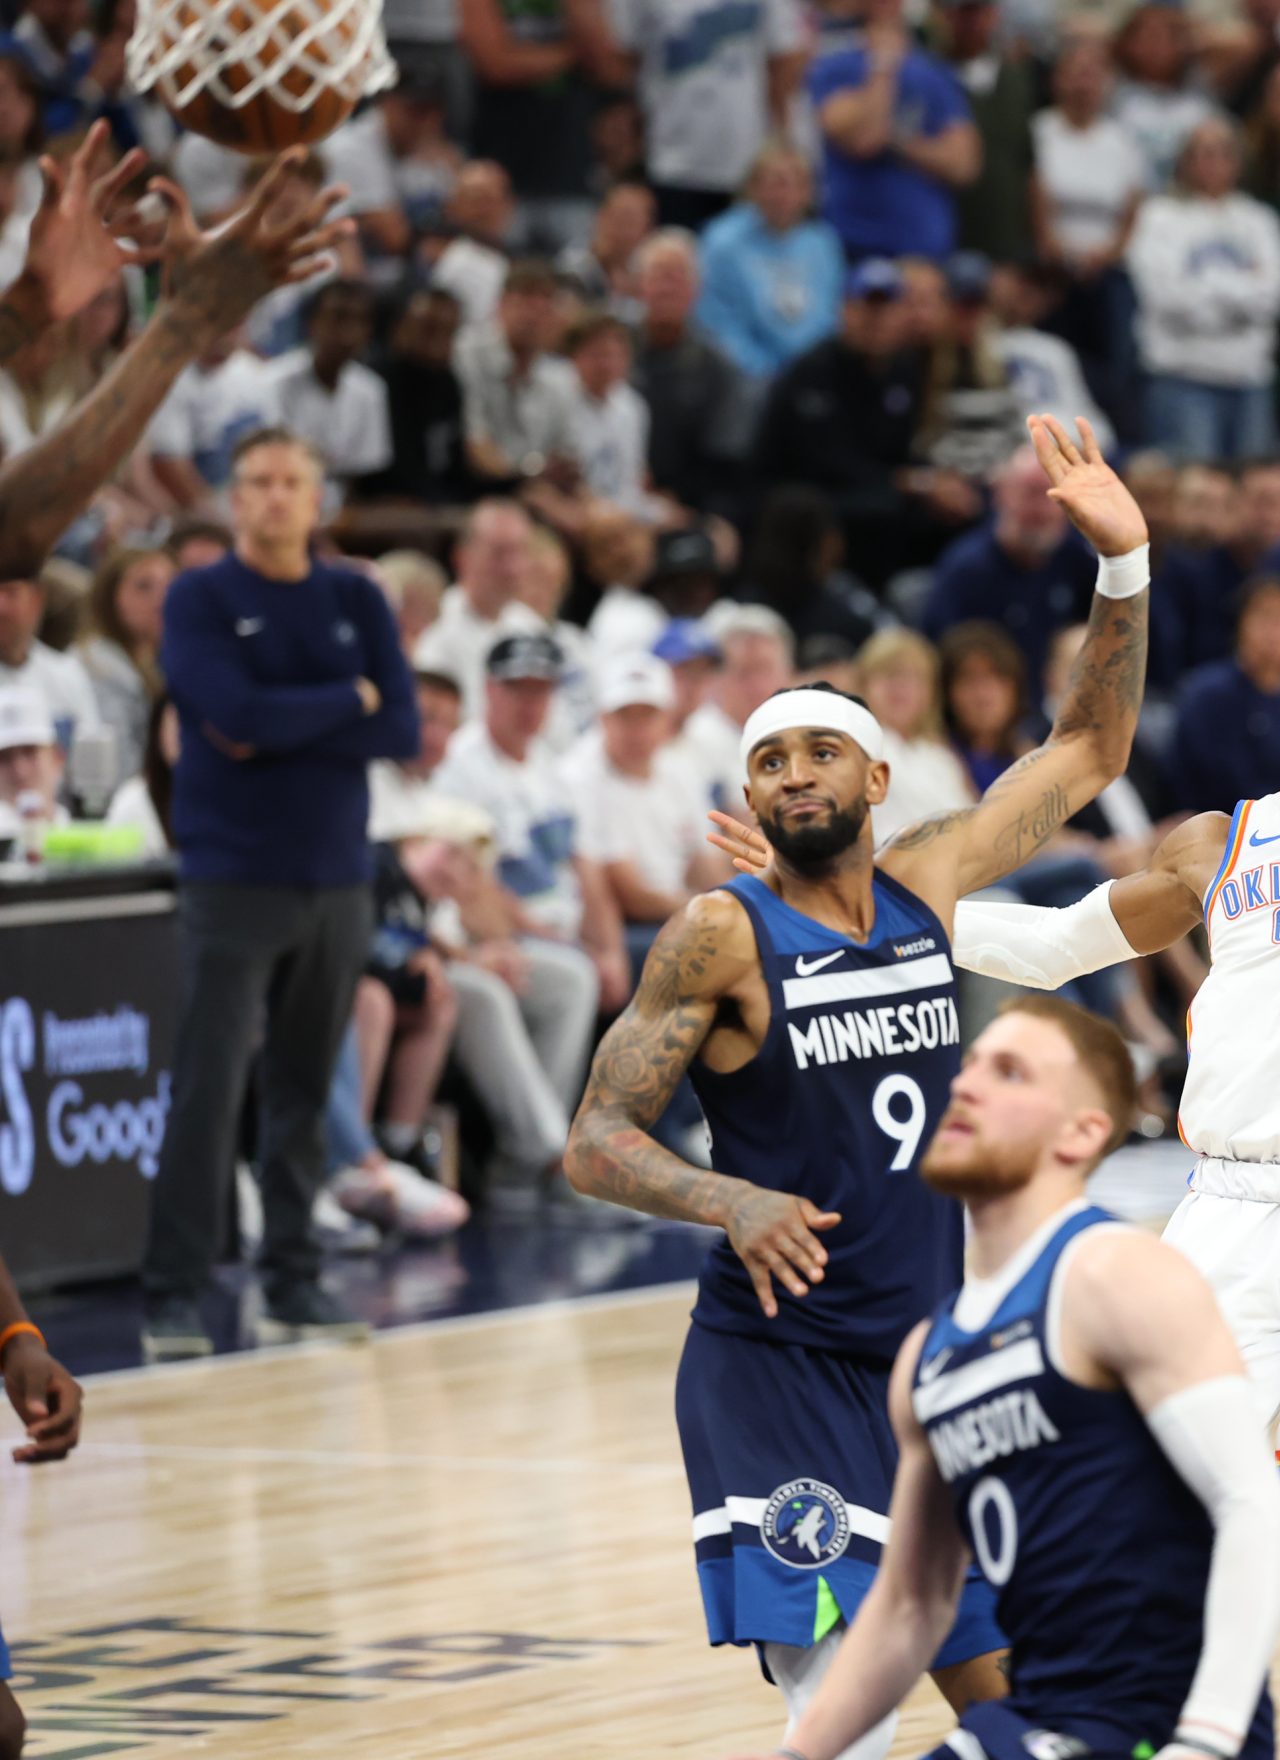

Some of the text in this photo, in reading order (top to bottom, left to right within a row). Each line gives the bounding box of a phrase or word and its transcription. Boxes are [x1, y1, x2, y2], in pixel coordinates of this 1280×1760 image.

[787, 997, 960, 1069] MINNESOTA
[47, 1069, 172, 1180] Goog
[872, 1073, 926, 1171] 9
[968, 1476, 1018, 1586] 0
